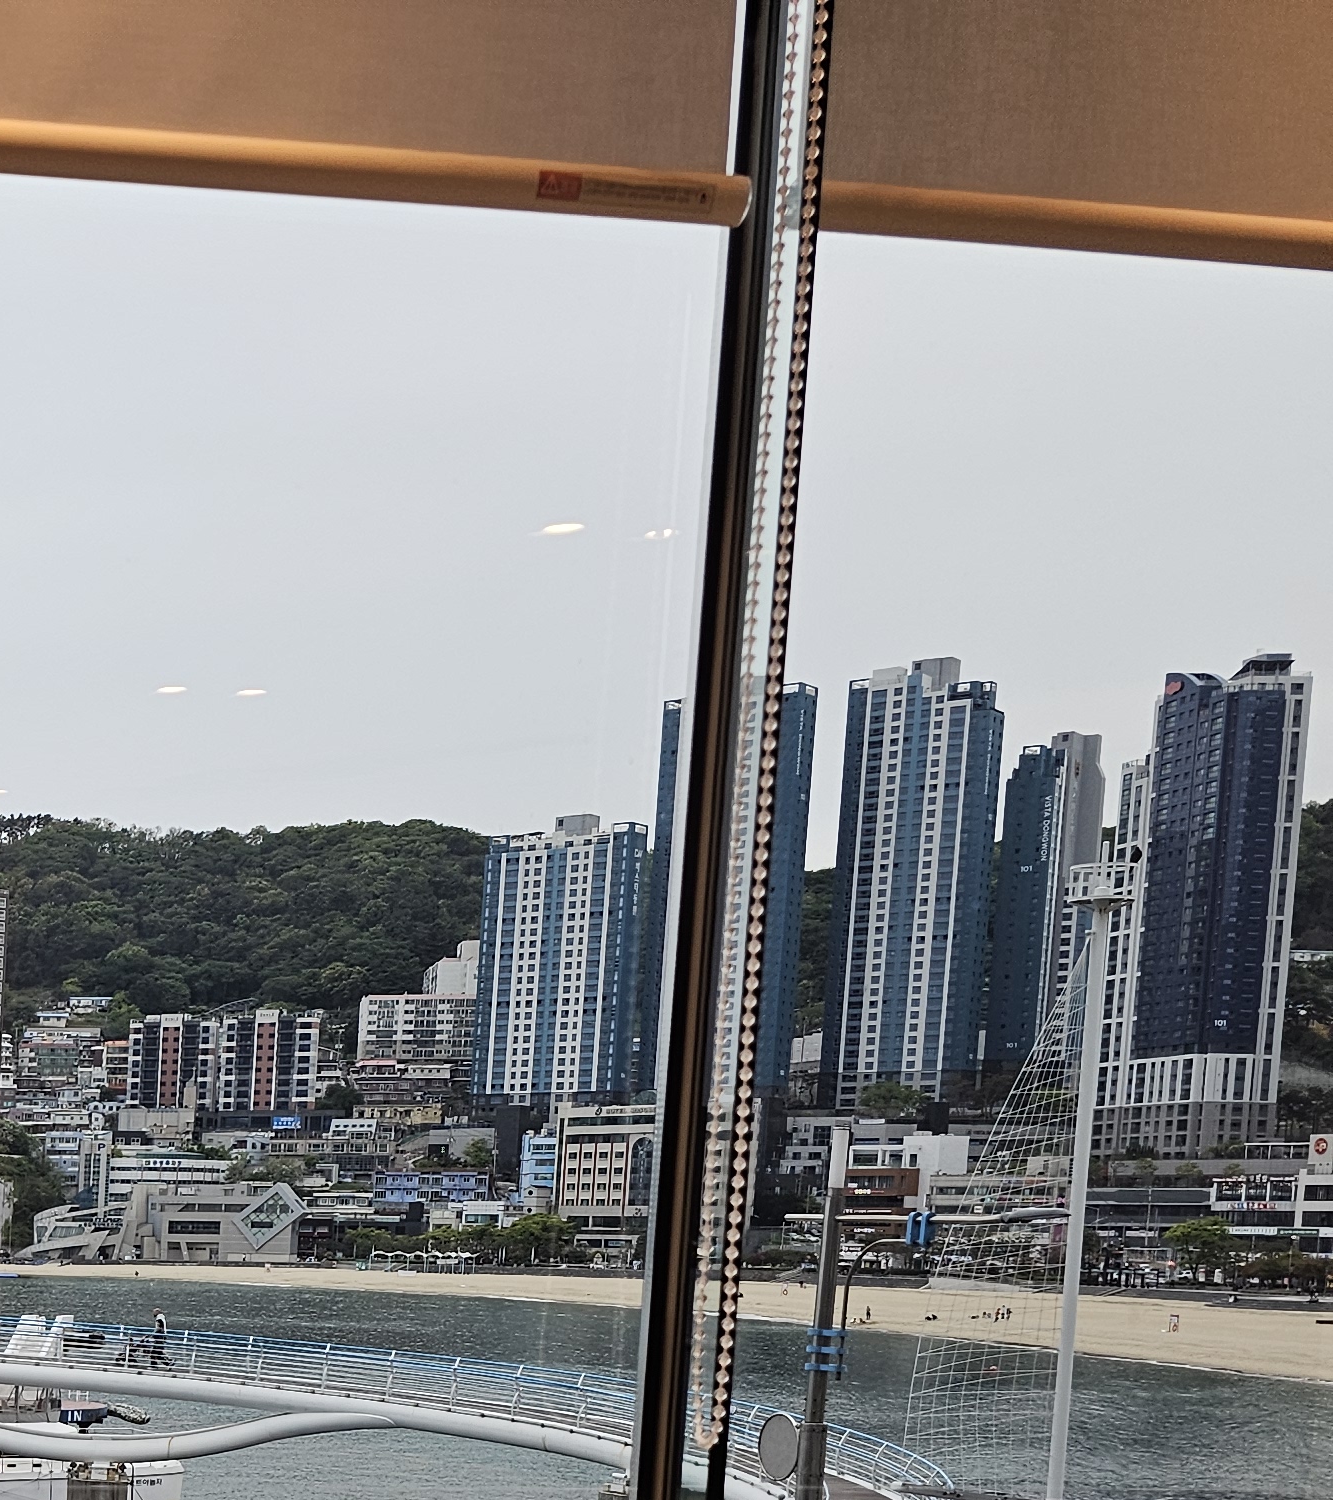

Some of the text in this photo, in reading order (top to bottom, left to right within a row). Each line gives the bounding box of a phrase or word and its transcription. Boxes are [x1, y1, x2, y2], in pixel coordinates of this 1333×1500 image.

[1040, 795, 1053, 861] VISTA DONGWON
[67, 1410, 83, 1422] IN
